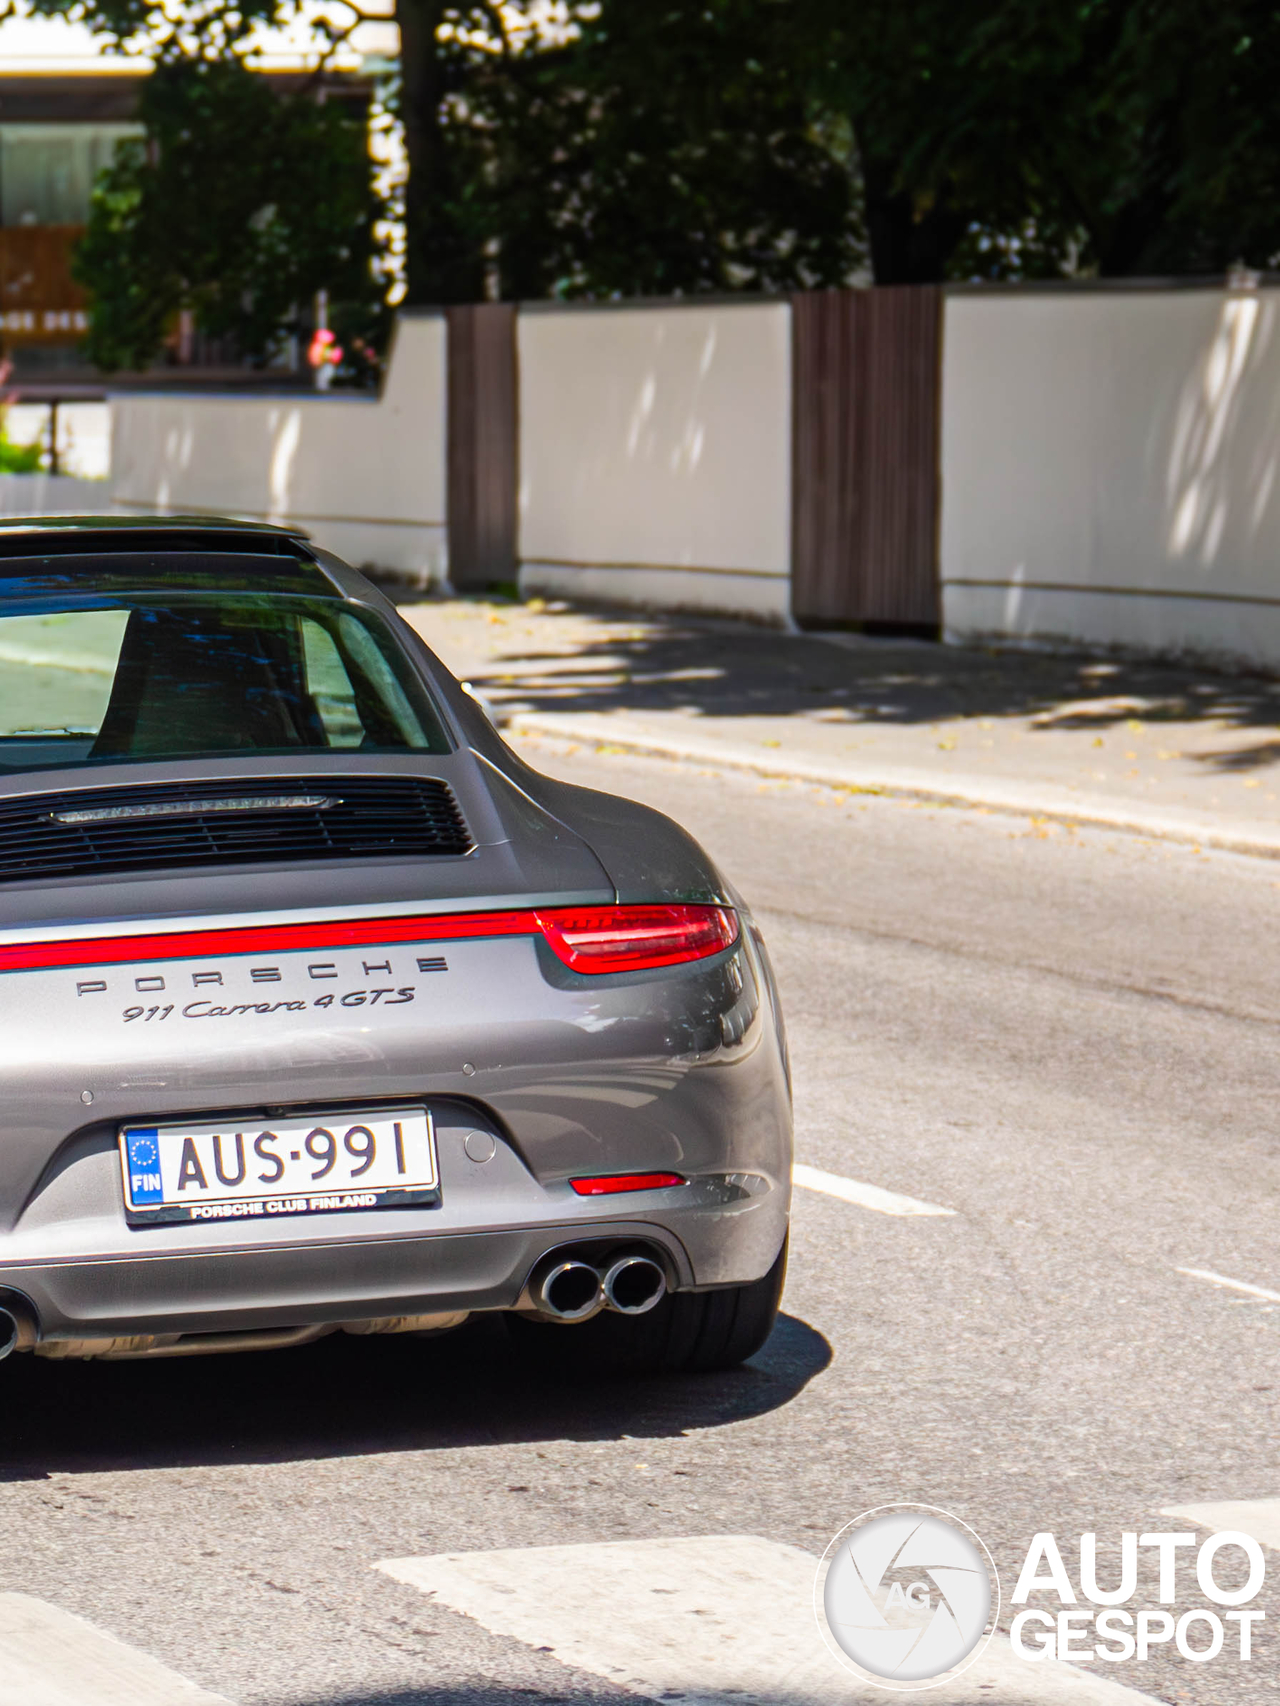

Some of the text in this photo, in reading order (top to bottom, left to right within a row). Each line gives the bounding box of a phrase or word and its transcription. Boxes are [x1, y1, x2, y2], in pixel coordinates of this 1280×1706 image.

[76, 956, 450, 997] PORSCHE
[122, 1003, 175, 1022] 911
[182, 1000, 307, 1018] Carrera
[340, 986, 416, 1007] GTS
[177, 1122, 407, 1191] AUS-991
[131, 1173, 162, 1192] FIN
[190, 1194, 378, 1219] PORSCHE CLUB FINLAND
